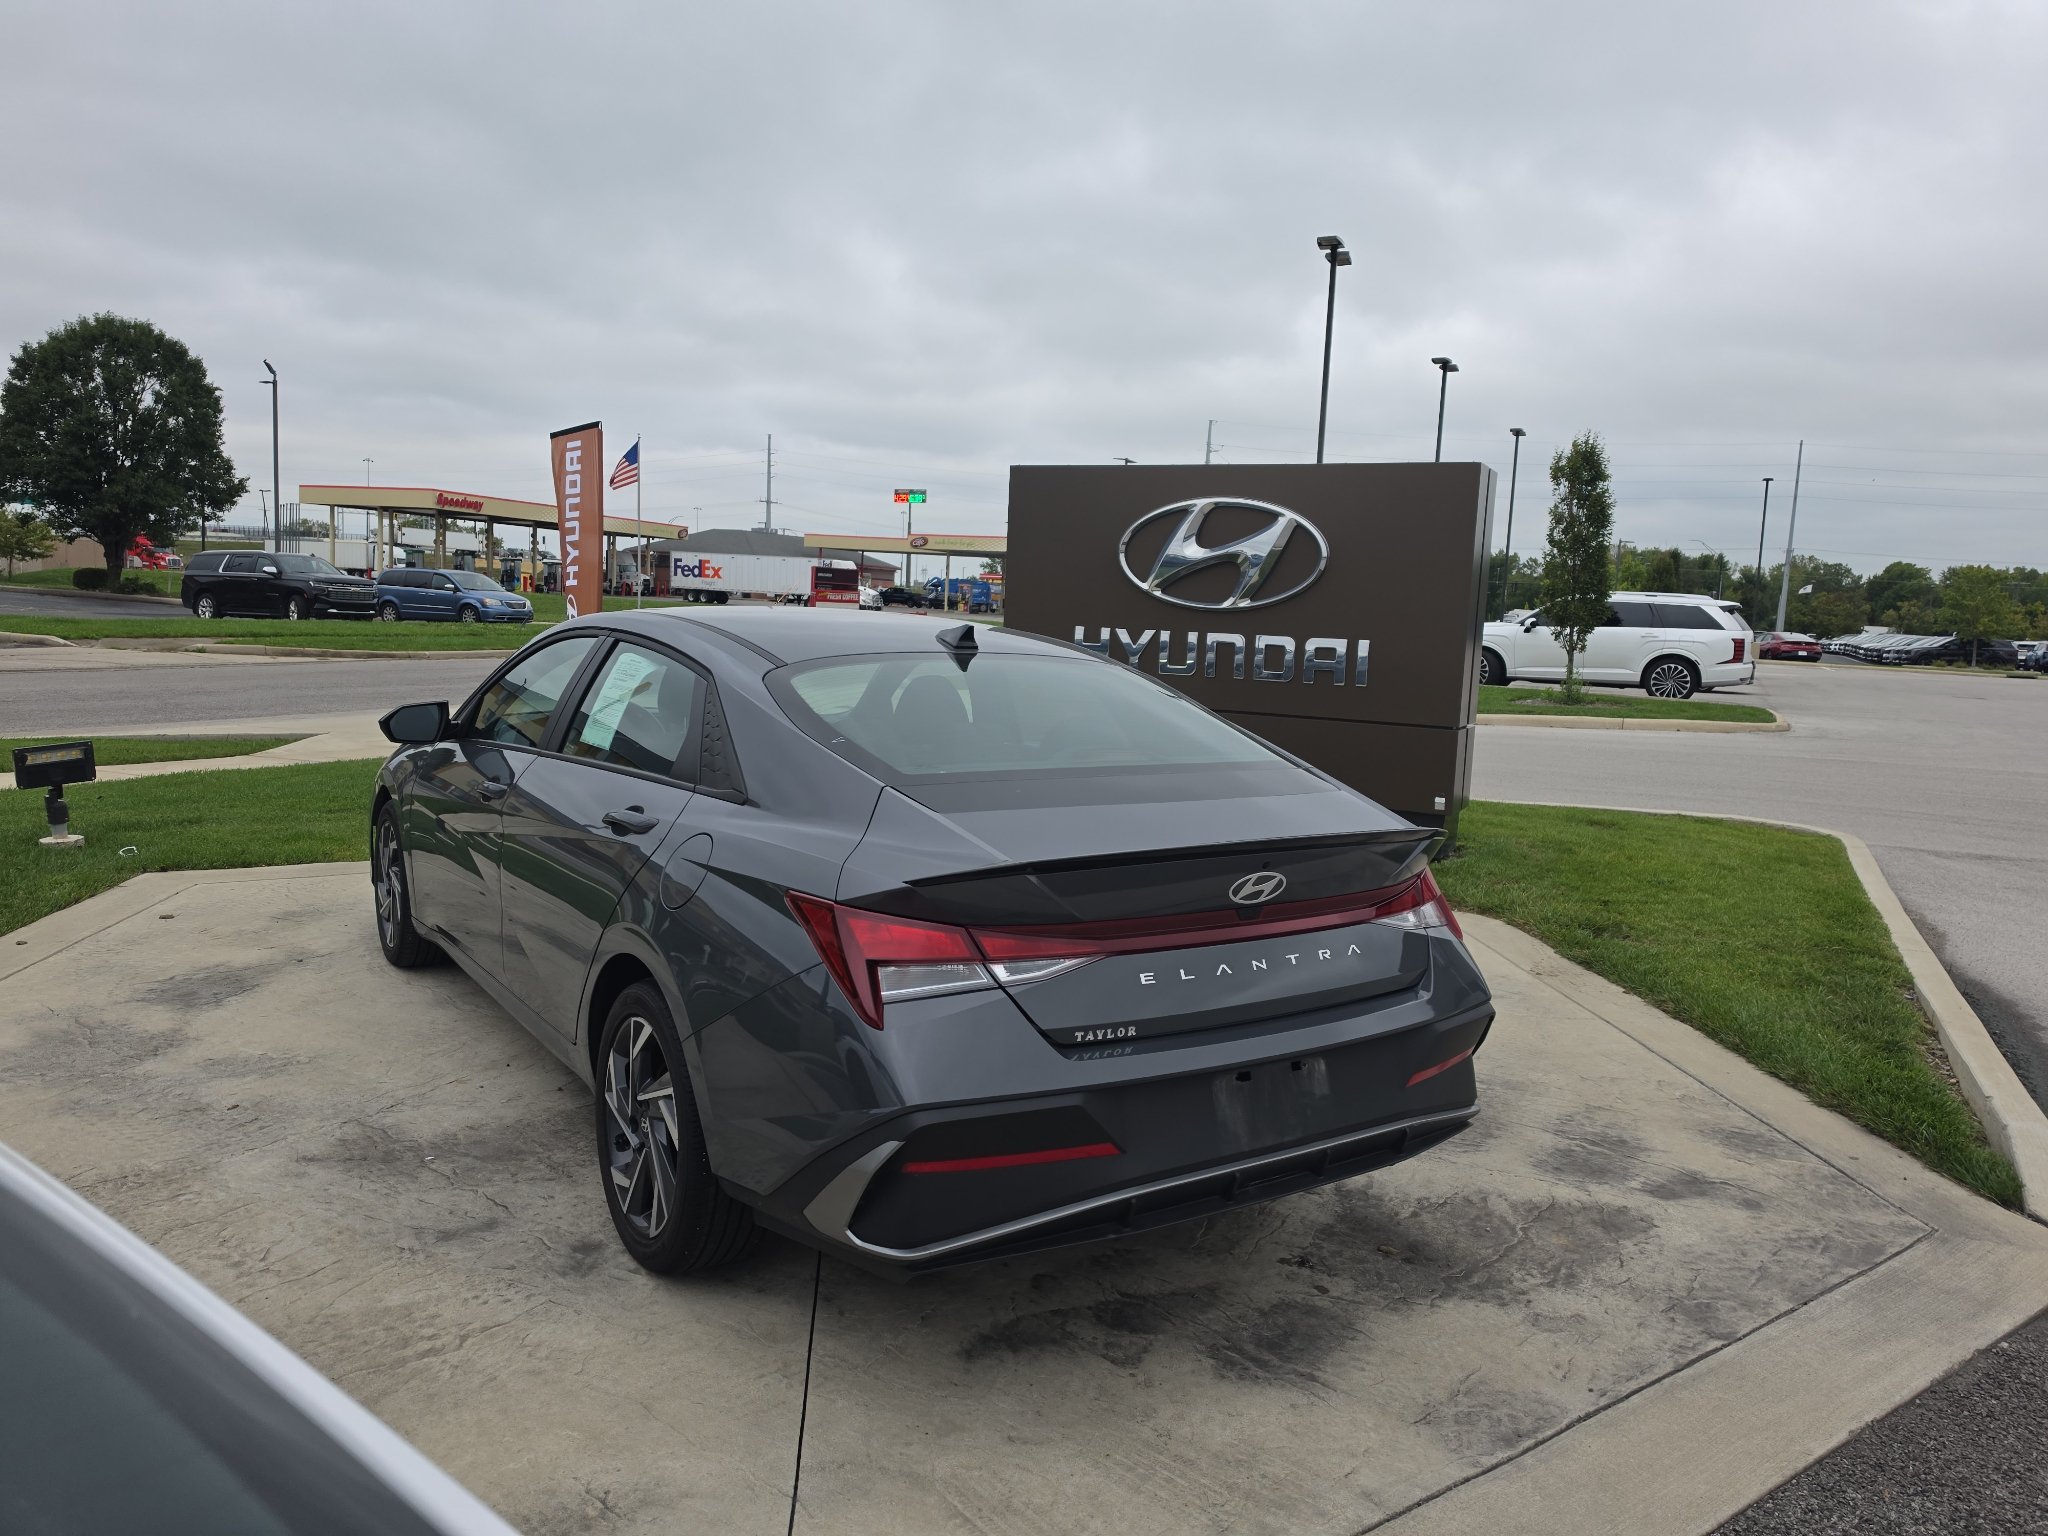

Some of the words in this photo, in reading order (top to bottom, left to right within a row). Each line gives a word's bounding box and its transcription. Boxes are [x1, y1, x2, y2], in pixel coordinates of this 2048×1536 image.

[436, 492, 484, 512] Speedway
[564, 439, 582, 587] HYUNDAI
[673, 558, 723, 579] FedEx
[1074, 625, 1371, 687] HYUNDAI
[1139, 944, 1362, 985] ELANTRA
[1074, 1026, 1137, 1042] TAYLOR
